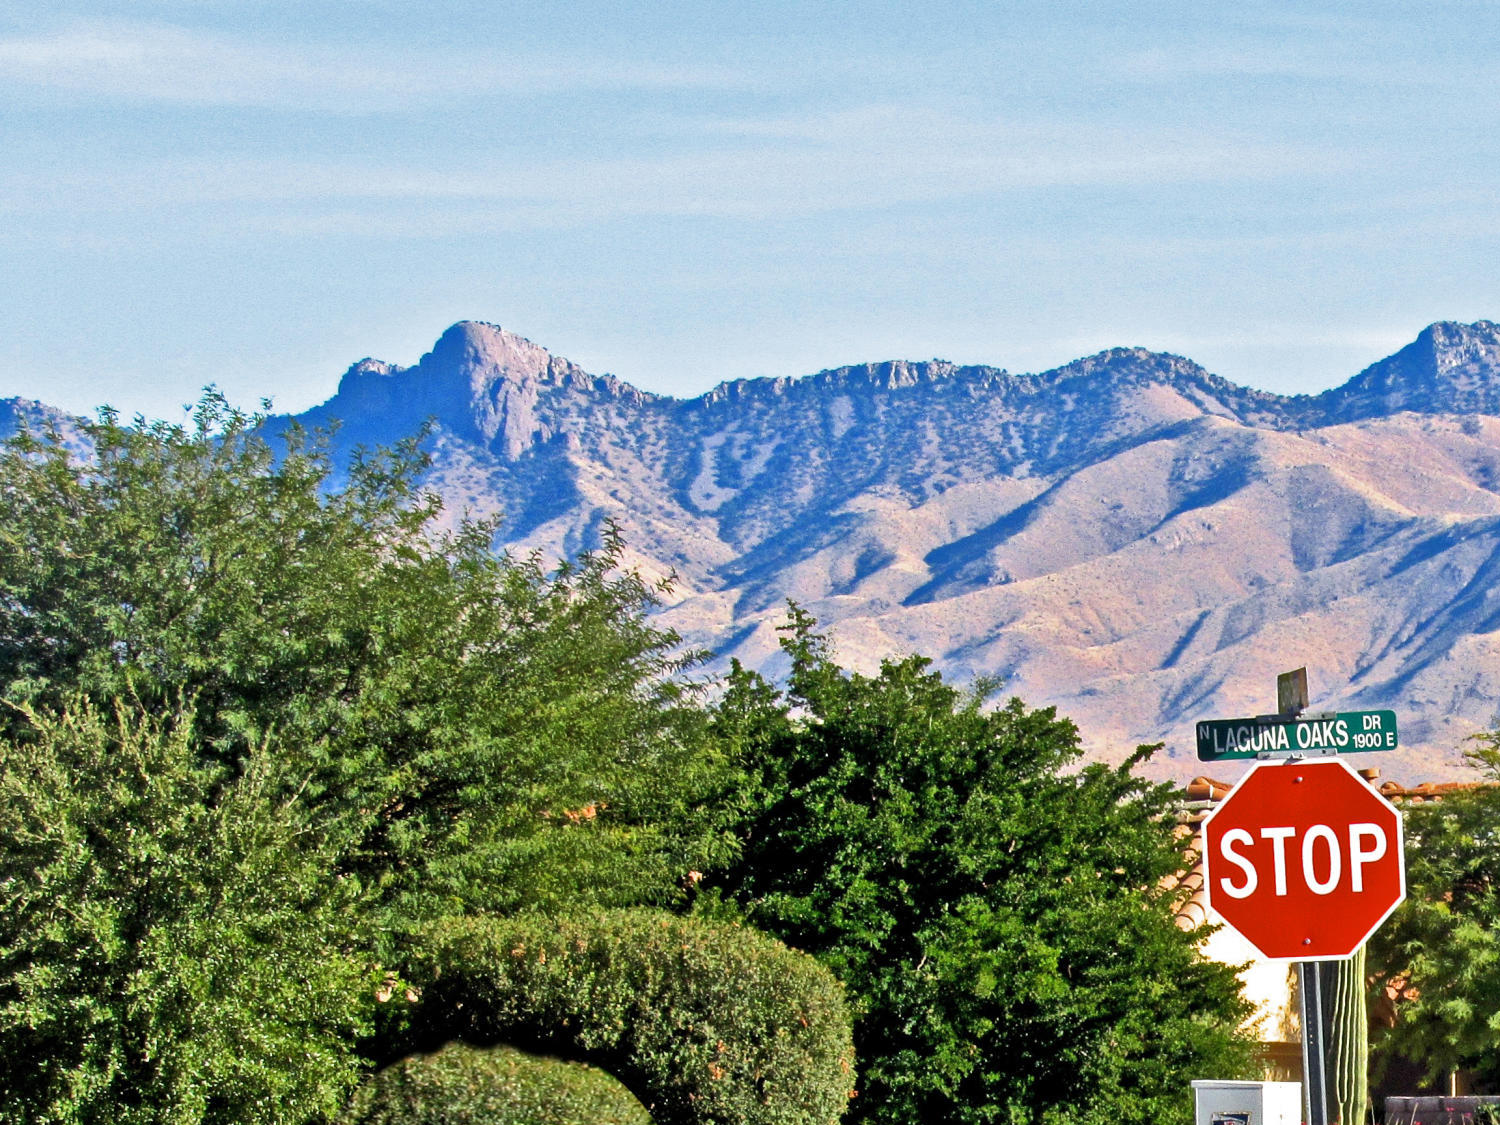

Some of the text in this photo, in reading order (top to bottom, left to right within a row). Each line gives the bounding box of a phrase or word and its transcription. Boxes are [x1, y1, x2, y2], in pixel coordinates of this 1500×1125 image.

[1362, 715, 1382, 730] DR
[1199, 720, 1349, 753] N LAGUNA OAKS
[1352, 732, 1395, 749] 1900 E
[1220, 823, 1387, 900] STOP
